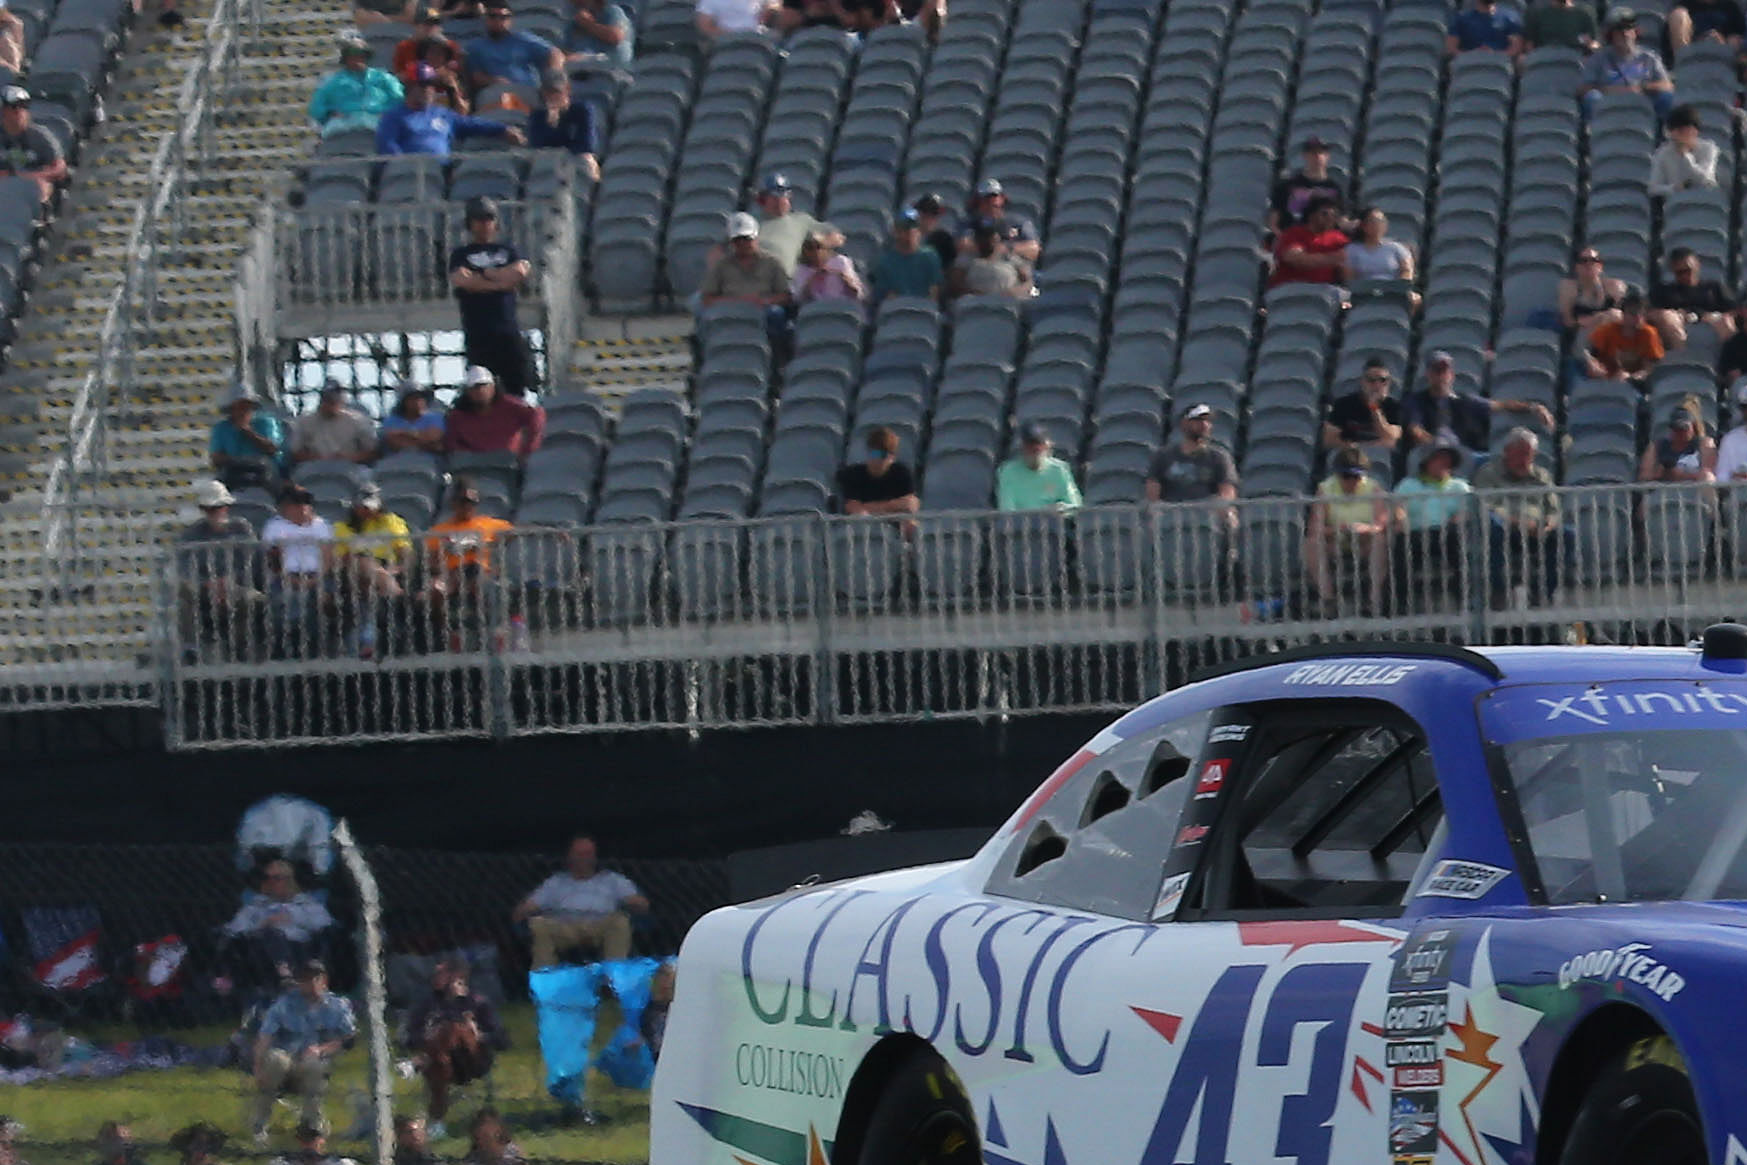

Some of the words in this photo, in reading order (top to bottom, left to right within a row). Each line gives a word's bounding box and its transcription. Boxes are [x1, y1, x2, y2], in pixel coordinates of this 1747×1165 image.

[741, 888, 1159, 1076] CLASSIC
[1559, 943, 1686, 1002] GOODYEAR
[737, 1043, 843, 1099] COLLISION
